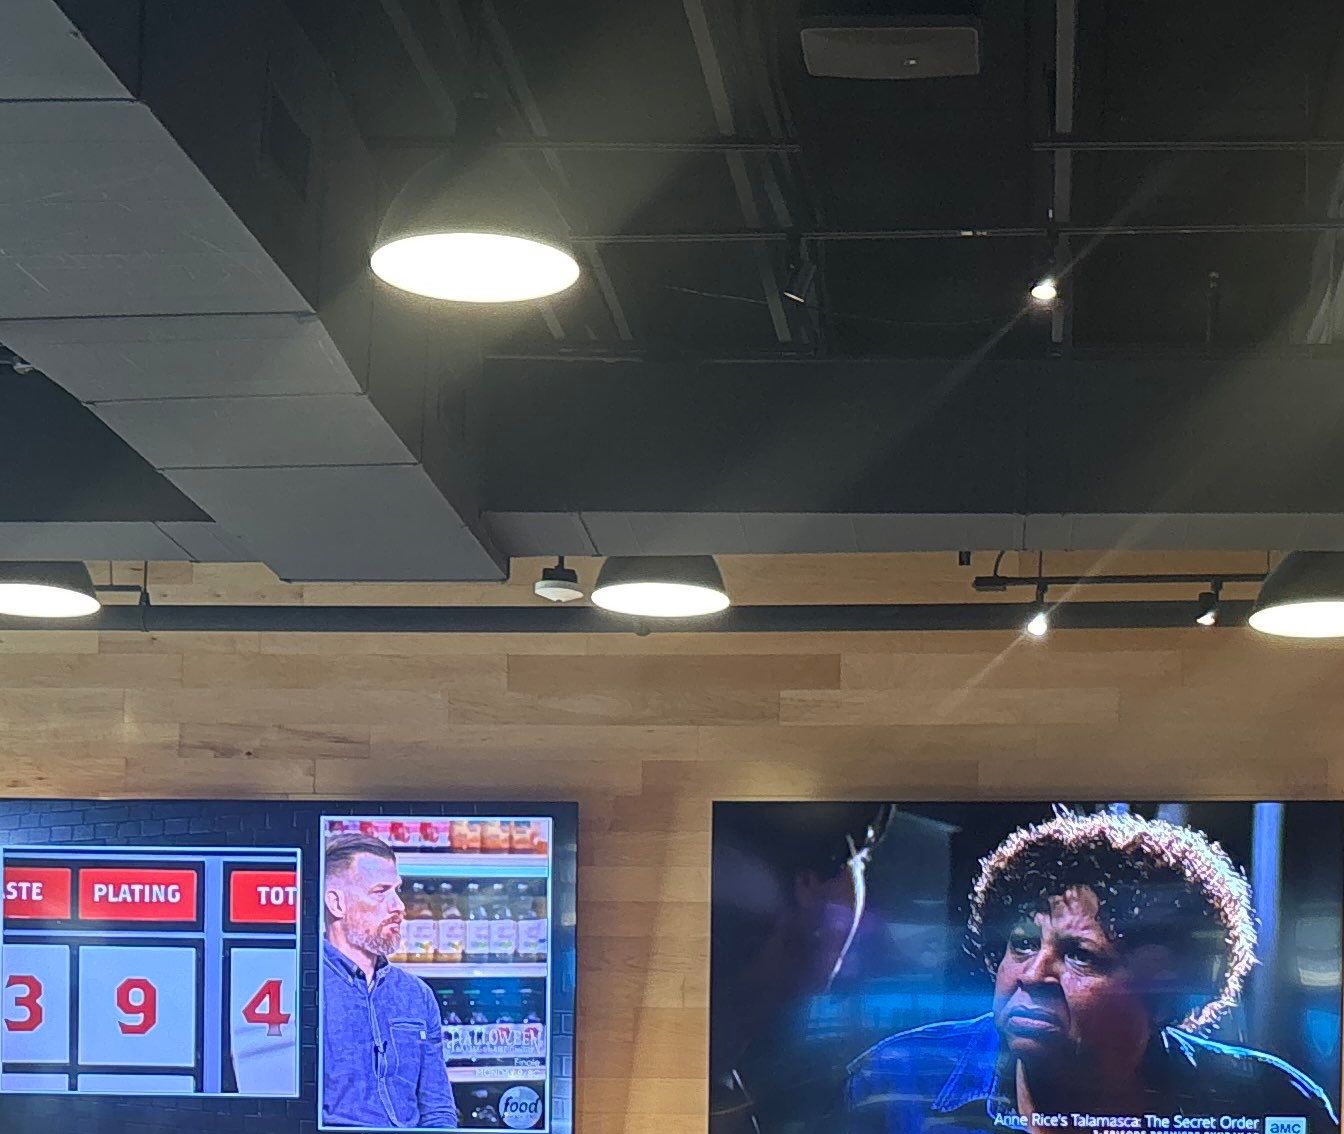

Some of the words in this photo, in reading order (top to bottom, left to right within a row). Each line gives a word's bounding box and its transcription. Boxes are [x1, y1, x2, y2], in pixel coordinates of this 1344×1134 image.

[1, 881, 43, 901] STE
[93, 883, 182, 904] PLATING
[3, 974, 44, 1032] 3
[115, 976, 158, 1036] 9
[241, 978, 292, 1038] 4
[503, 1096, 540, 1114] food
[993, 1112, 1028, 1127] Anne
[1031, 1113, 1068, 1127] Rice's
[1071, 1113, 1141, 1128] Talamasca:
[1144, 1114, 1170, 1129] The
[1173, 1115, 1216, 1129] Secret
[1219, 1115, 1260, 1130] Order
